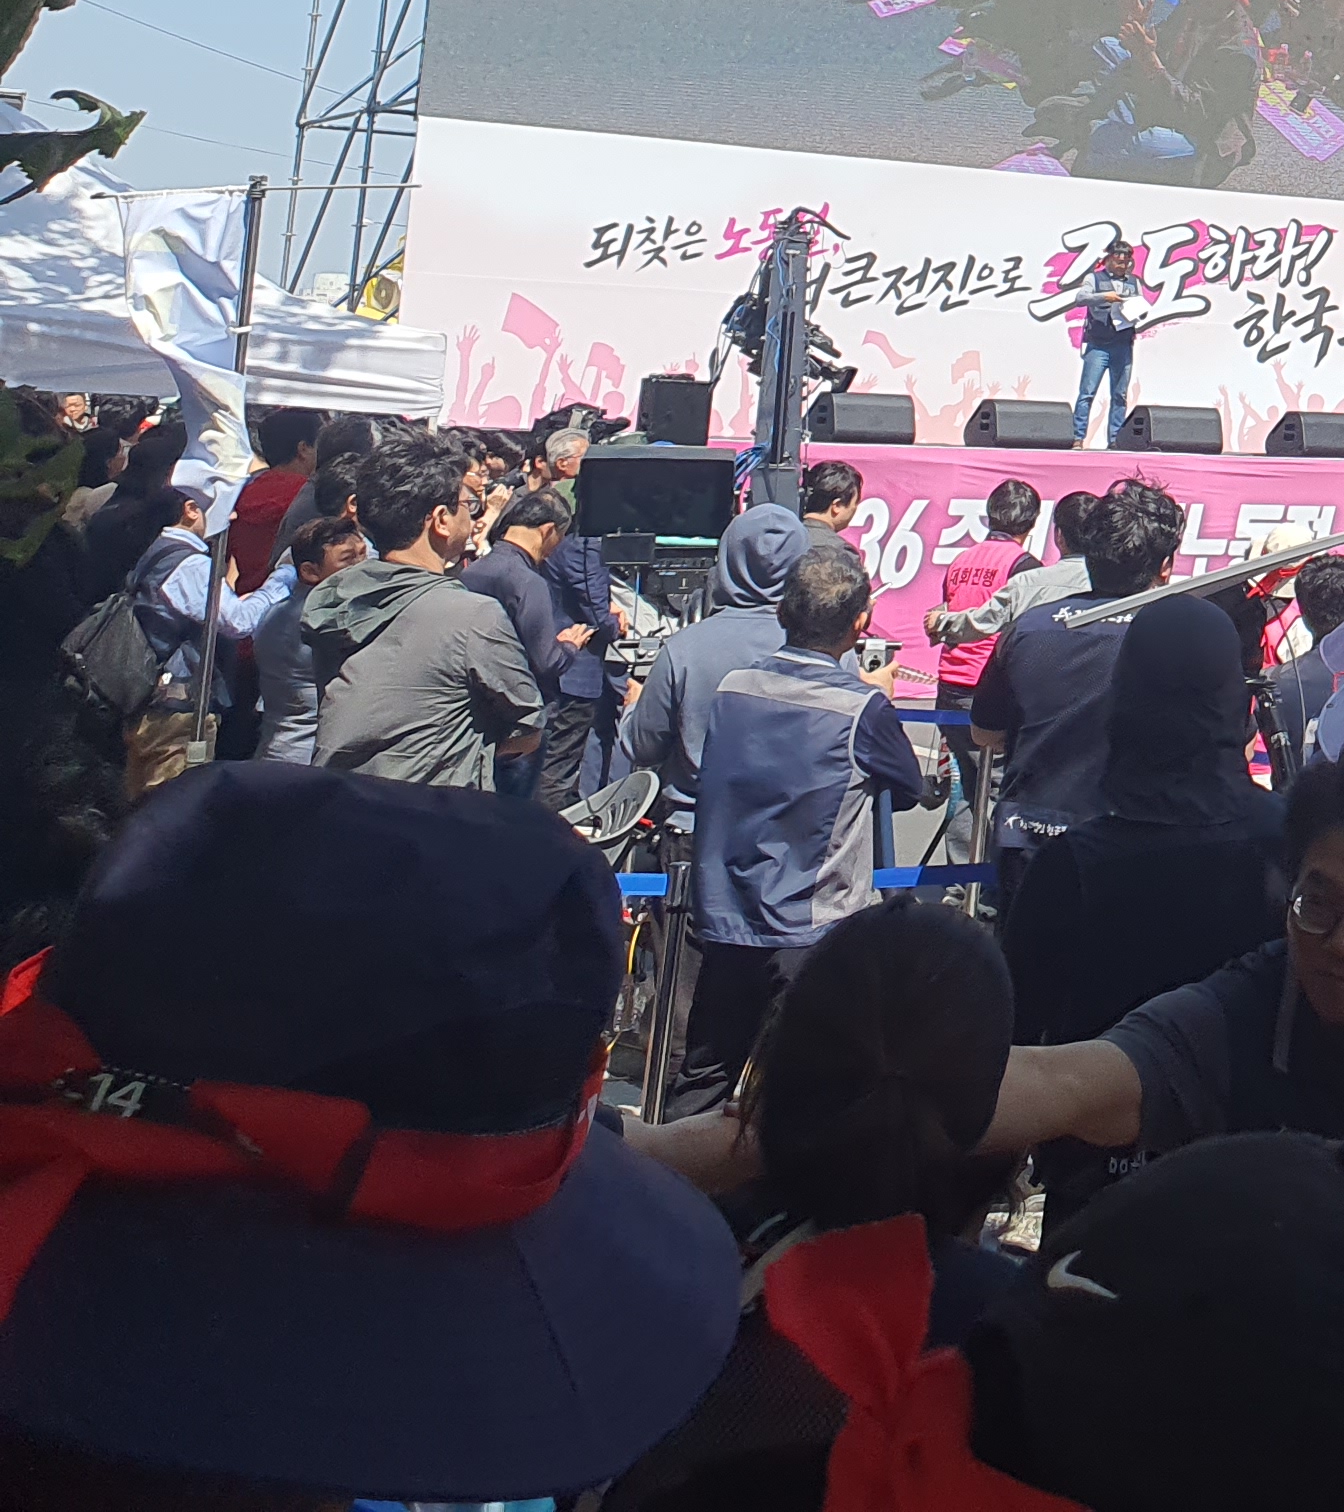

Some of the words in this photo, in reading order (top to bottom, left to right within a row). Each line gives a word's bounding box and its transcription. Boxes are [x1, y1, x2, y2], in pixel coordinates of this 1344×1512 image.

[583, 215, 708, 272] 되찾은
[876, 254, 1031, 316] 전진으로
[949, 567, 999, 588] 대회진행
